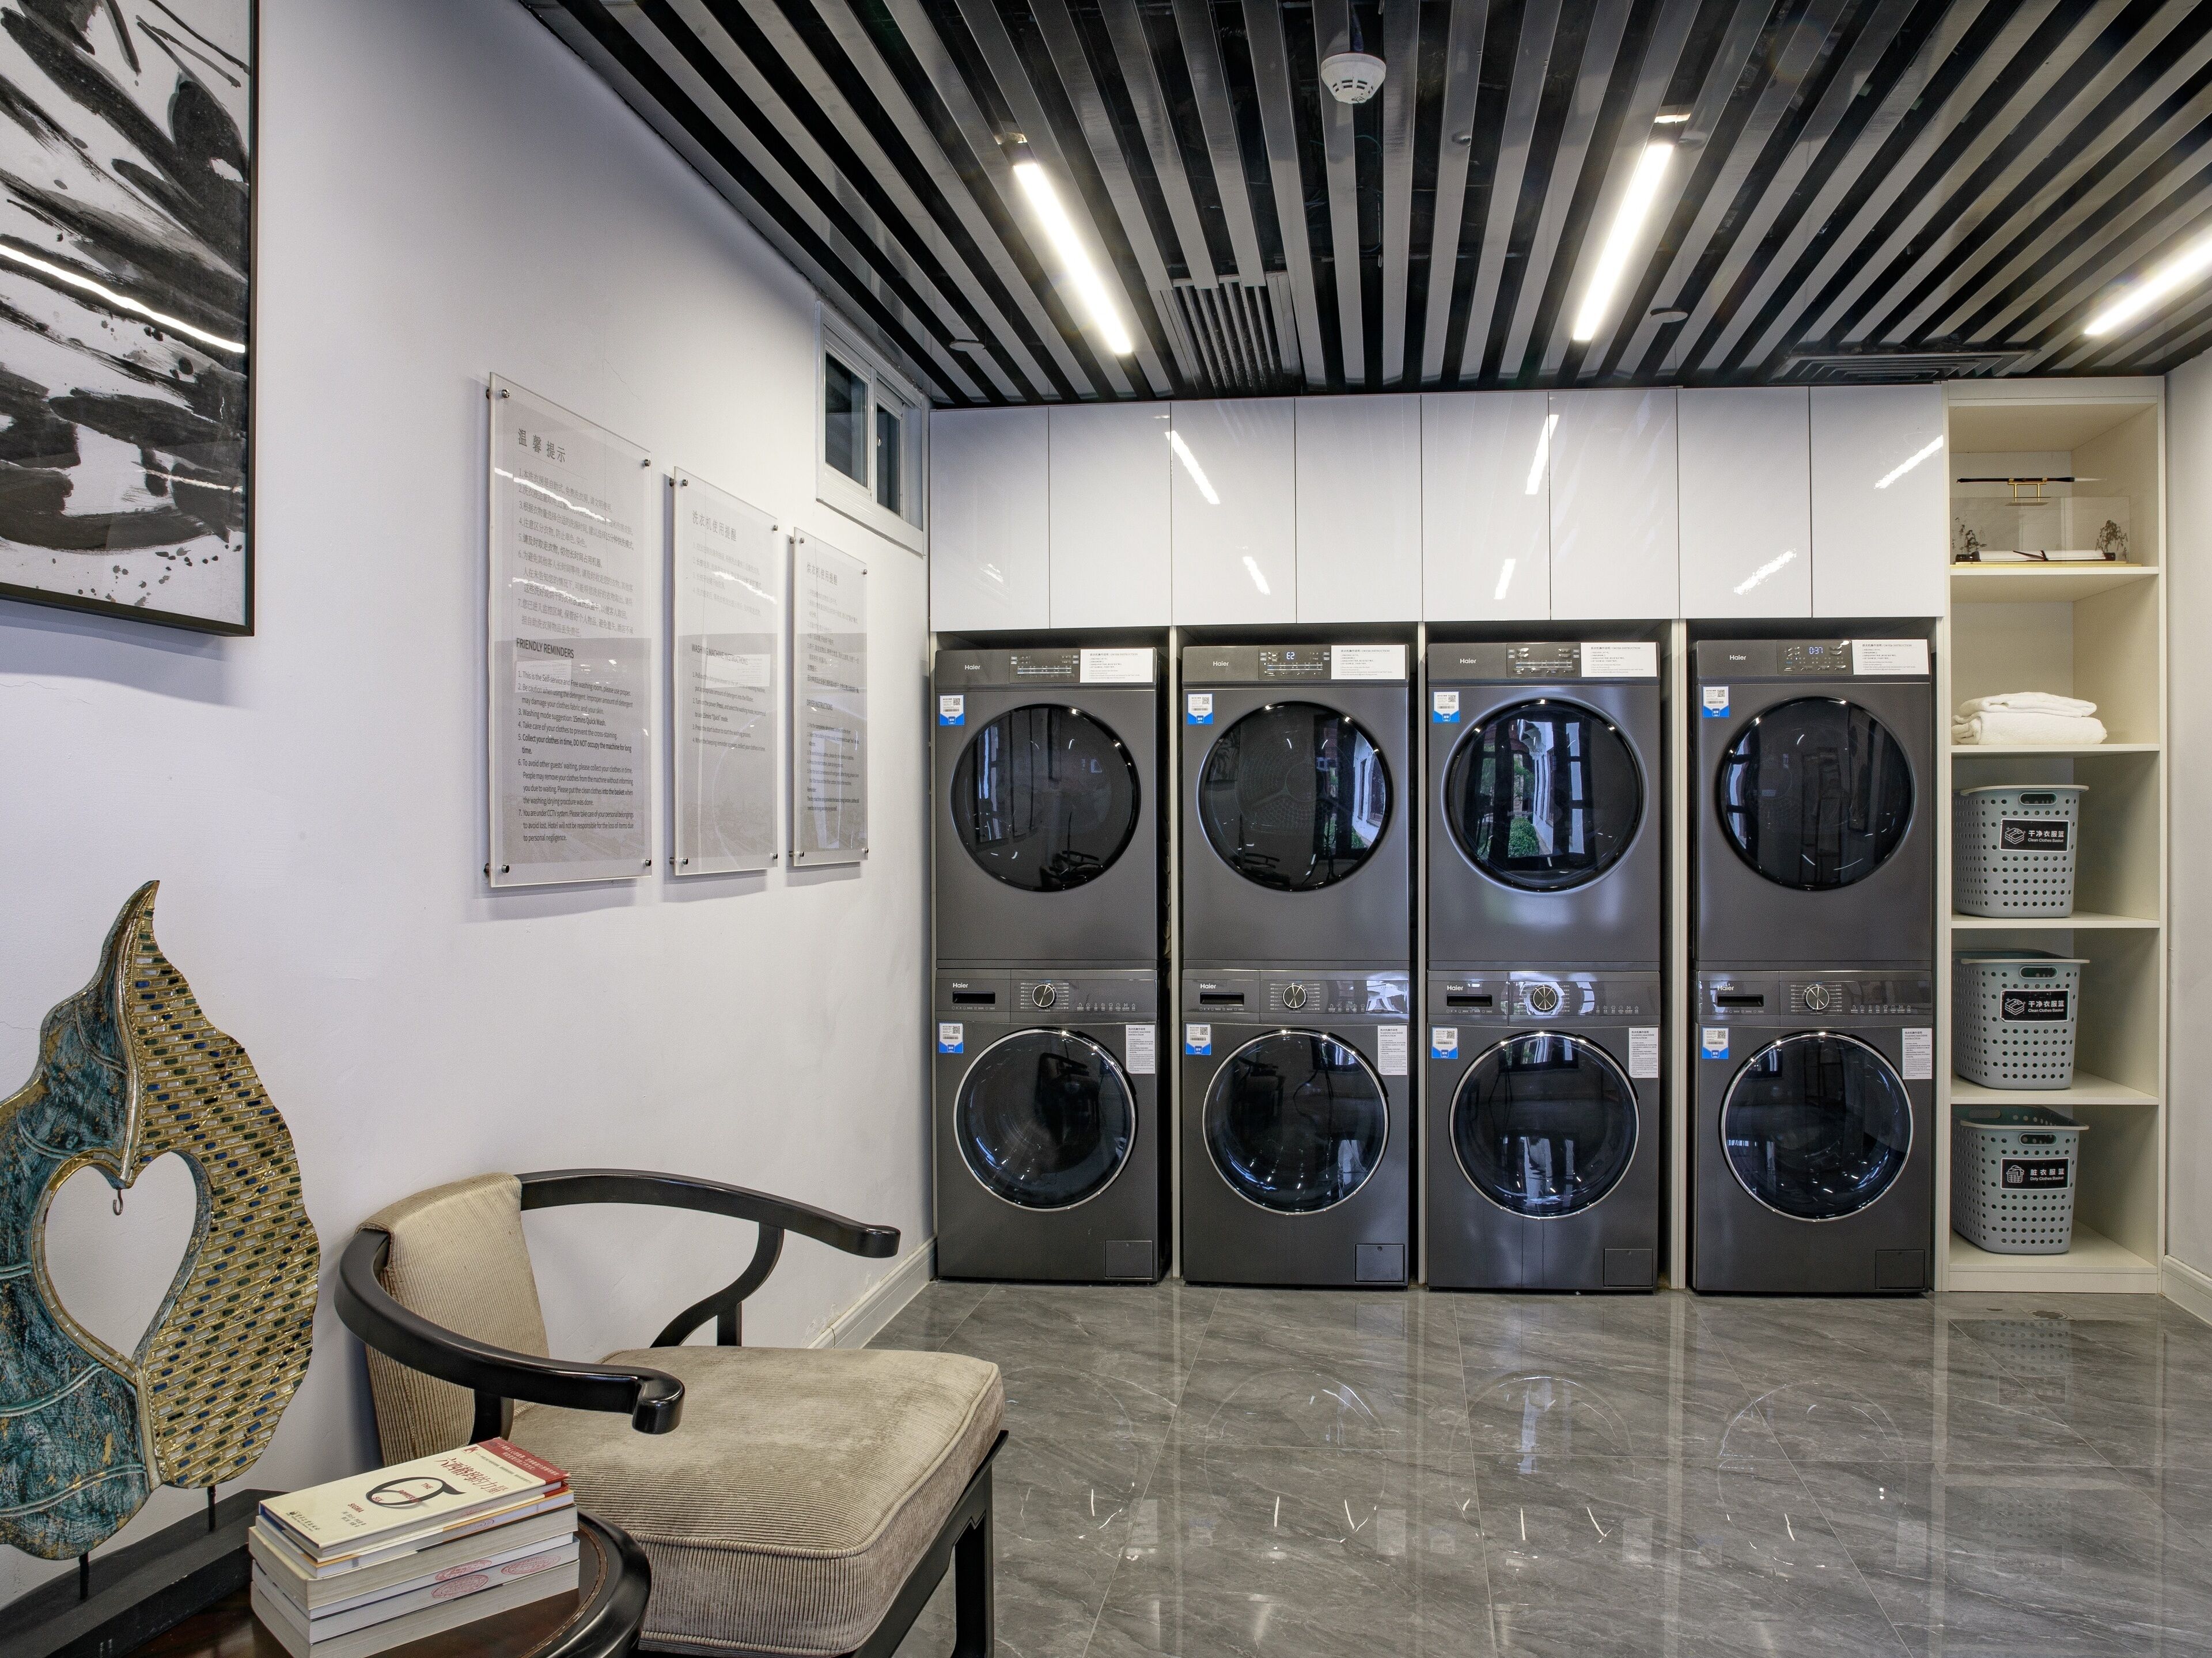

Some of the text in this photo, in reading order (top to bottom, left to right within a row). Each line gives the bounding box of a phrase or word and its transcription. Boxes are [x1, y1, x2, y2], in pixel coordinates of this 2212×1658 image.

[518, 428, 565, 464] 温馨提示
[516, 637, 574, 659] FRIENDLY REMINDERS
[523, 708, 539, 719] Washing
[540, 711, 551, 719] mode
[573, 715, 586, 724] 15mins
[586, 717, 596, 726] Quick
[546, 724, 555, 733] your
[555, 725, 569, 733] clothes
[574, 728, 587, 737] prevent
[522, 733, 535, 742] Collect
[536, 735, 545, 745] your
[546, 735, 559, 744] clothes
[587, 741, 599, 750] occupy
[605, 742, 619, 750] machine
[522, 746, 532, 754] time.
[539, 760, 550, 768] other
[578, 762, 589, 771] please
[523, 771, 536, 780] People
[567, 774, 578, 782] clothes
[528, 834, 545, 843] personal
[2030, 1168, 2065, 1176] 脏衣服篮
[435, 1456, 508, 1496] 六西格玛的力量
[399, 1489, 416, 1500] POWER
[347, 1503, 365, 1513] SIGMA
